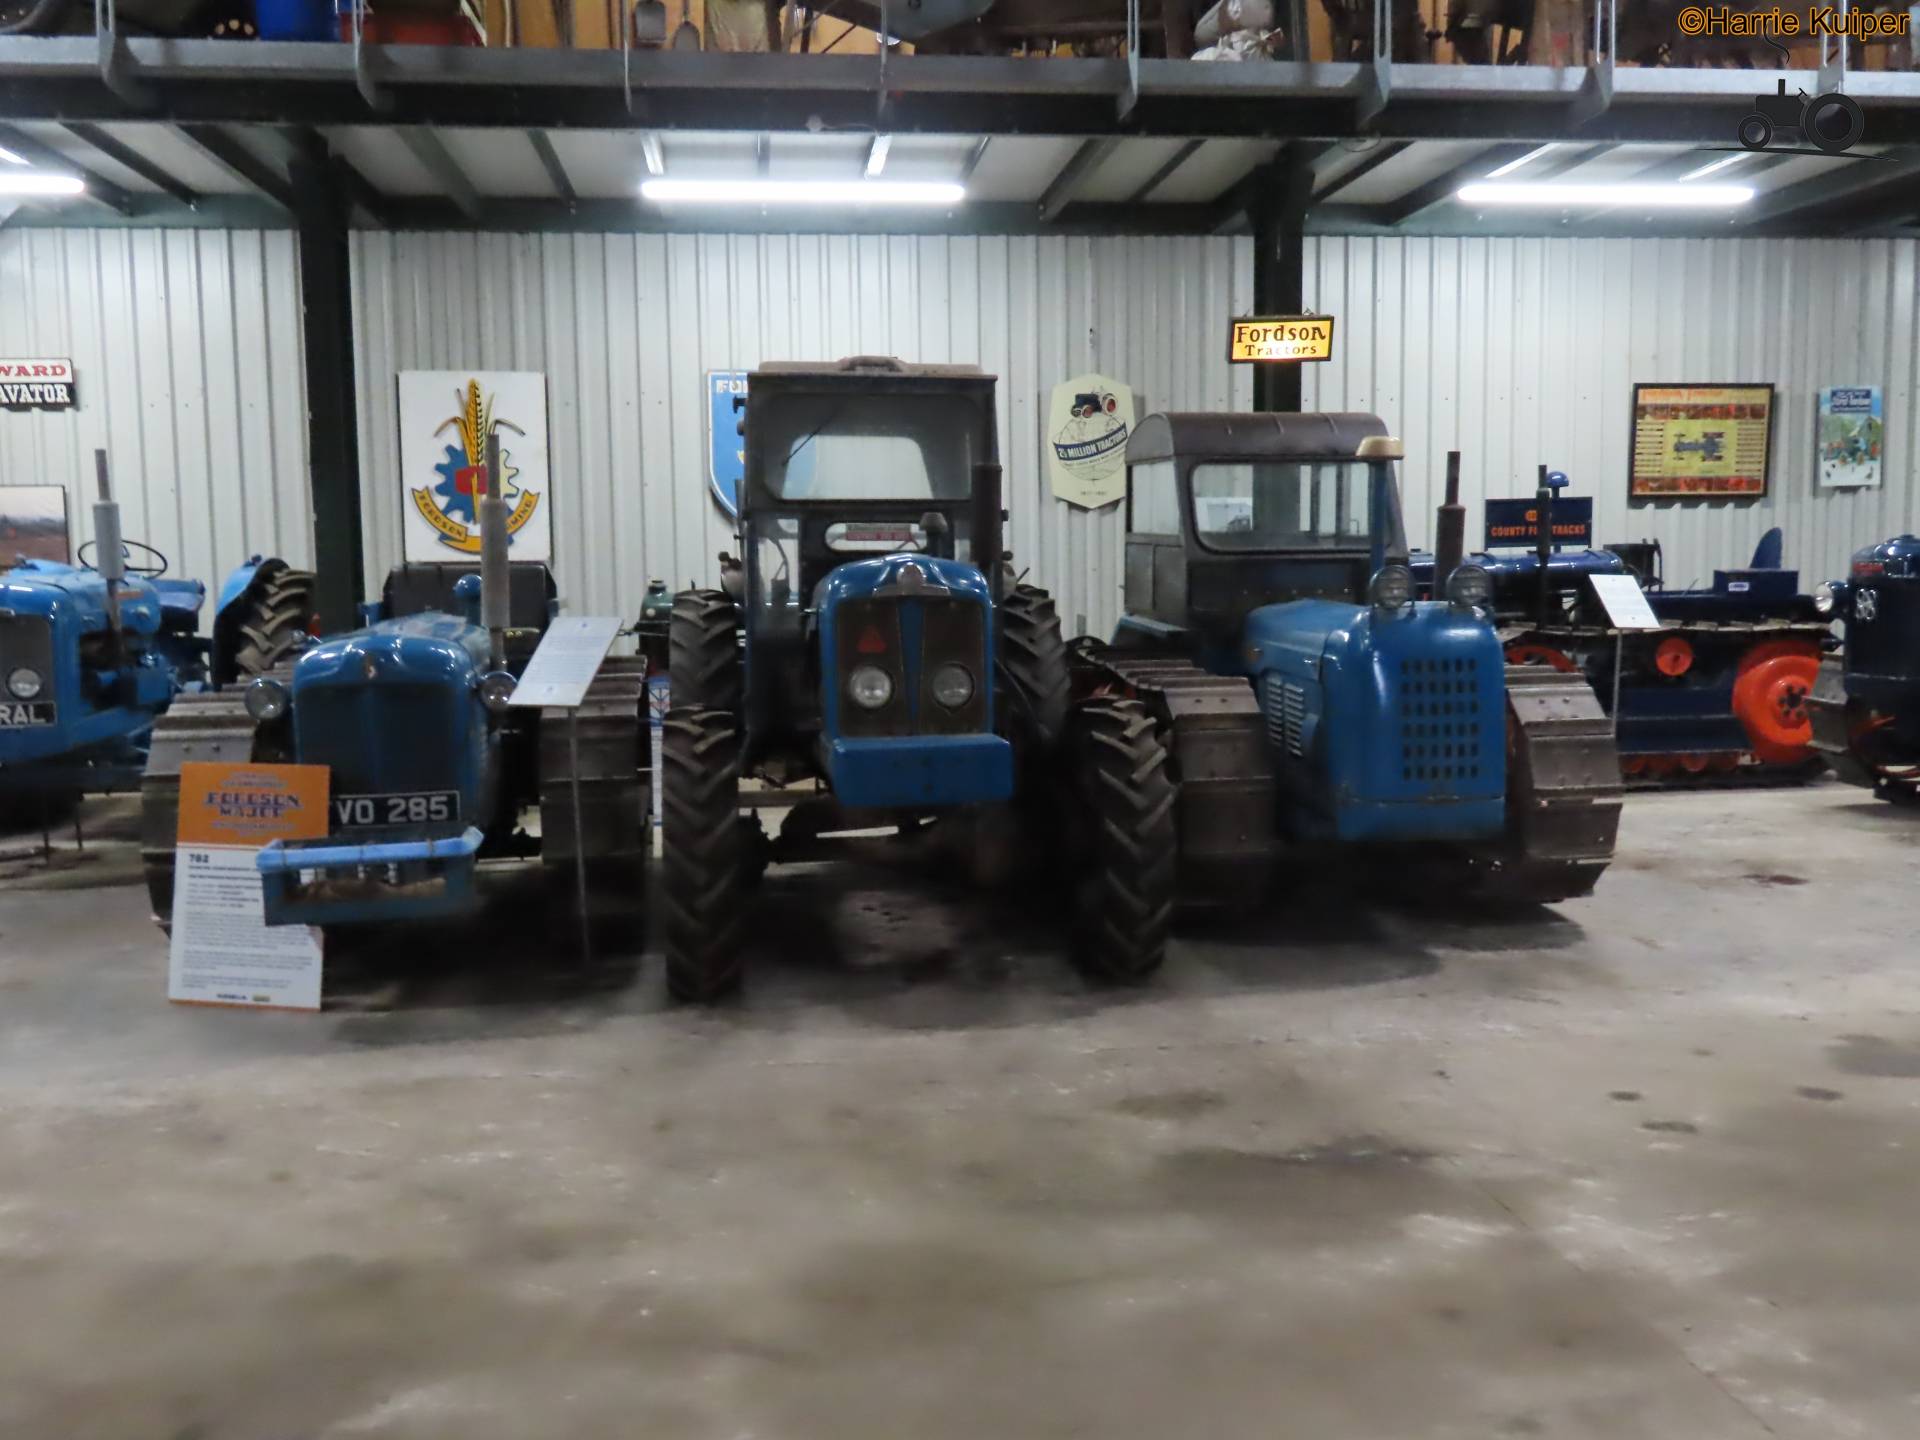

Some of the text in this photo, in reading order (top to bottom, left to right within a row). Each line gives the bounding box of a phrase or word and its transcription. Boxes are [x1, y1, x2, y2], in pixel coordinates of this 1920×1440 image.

[1236, 324, 1326, 343] Fordson
[1245, 344, 1317, 356] Tractors
[1068, 443, 1097, 457] MILLION
[1097, 430, 1127, 452] TRACTORS
[1491, 526, 1526, 537] COUNTY
[1552, 524, 1585, 535] TRACKS
[331, 796, 448, 824] VO 285
